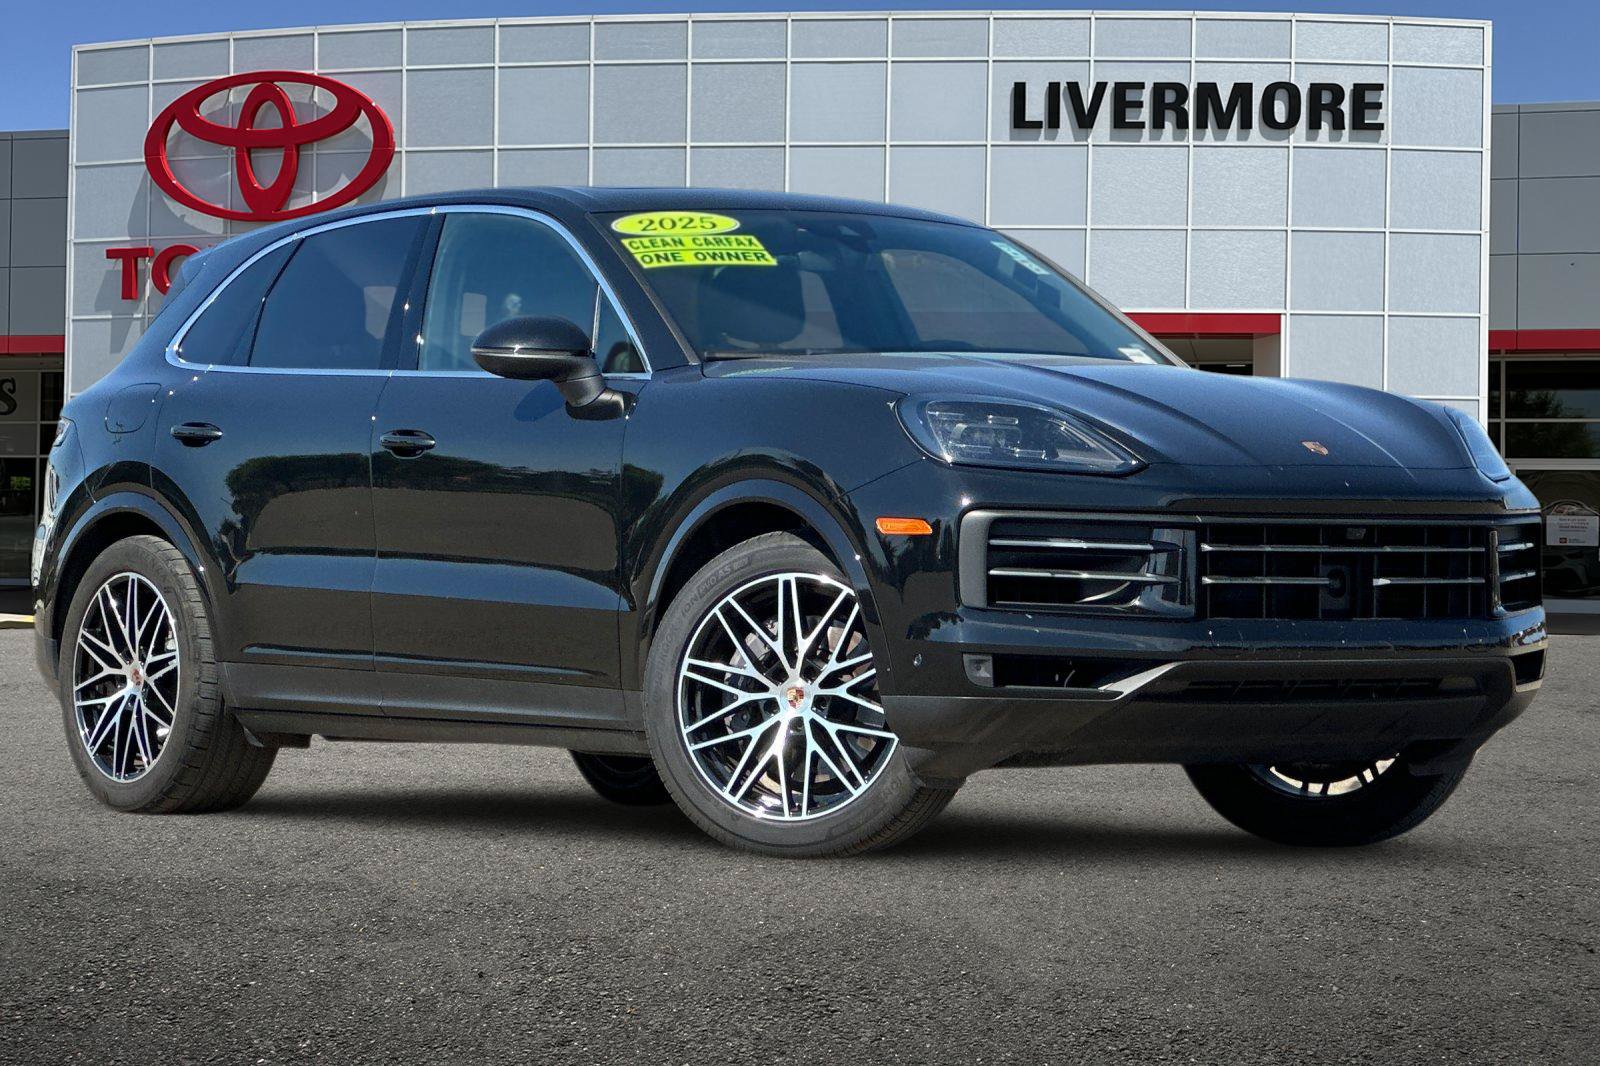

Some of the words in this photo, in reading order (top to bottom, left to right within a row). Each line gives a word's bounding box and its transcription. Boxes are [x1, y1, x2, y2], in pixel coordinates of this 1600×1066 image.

[1011, 81, 1385, 131] LIVERMORE
[638, 215, 718, 232] 2025
[628, 237, 686, 251] CLEAN
[692, 235, 759, 248] CARFAX
[639, 252, 686, 266] ONE
[694, 251, 771, 263] OWNER
